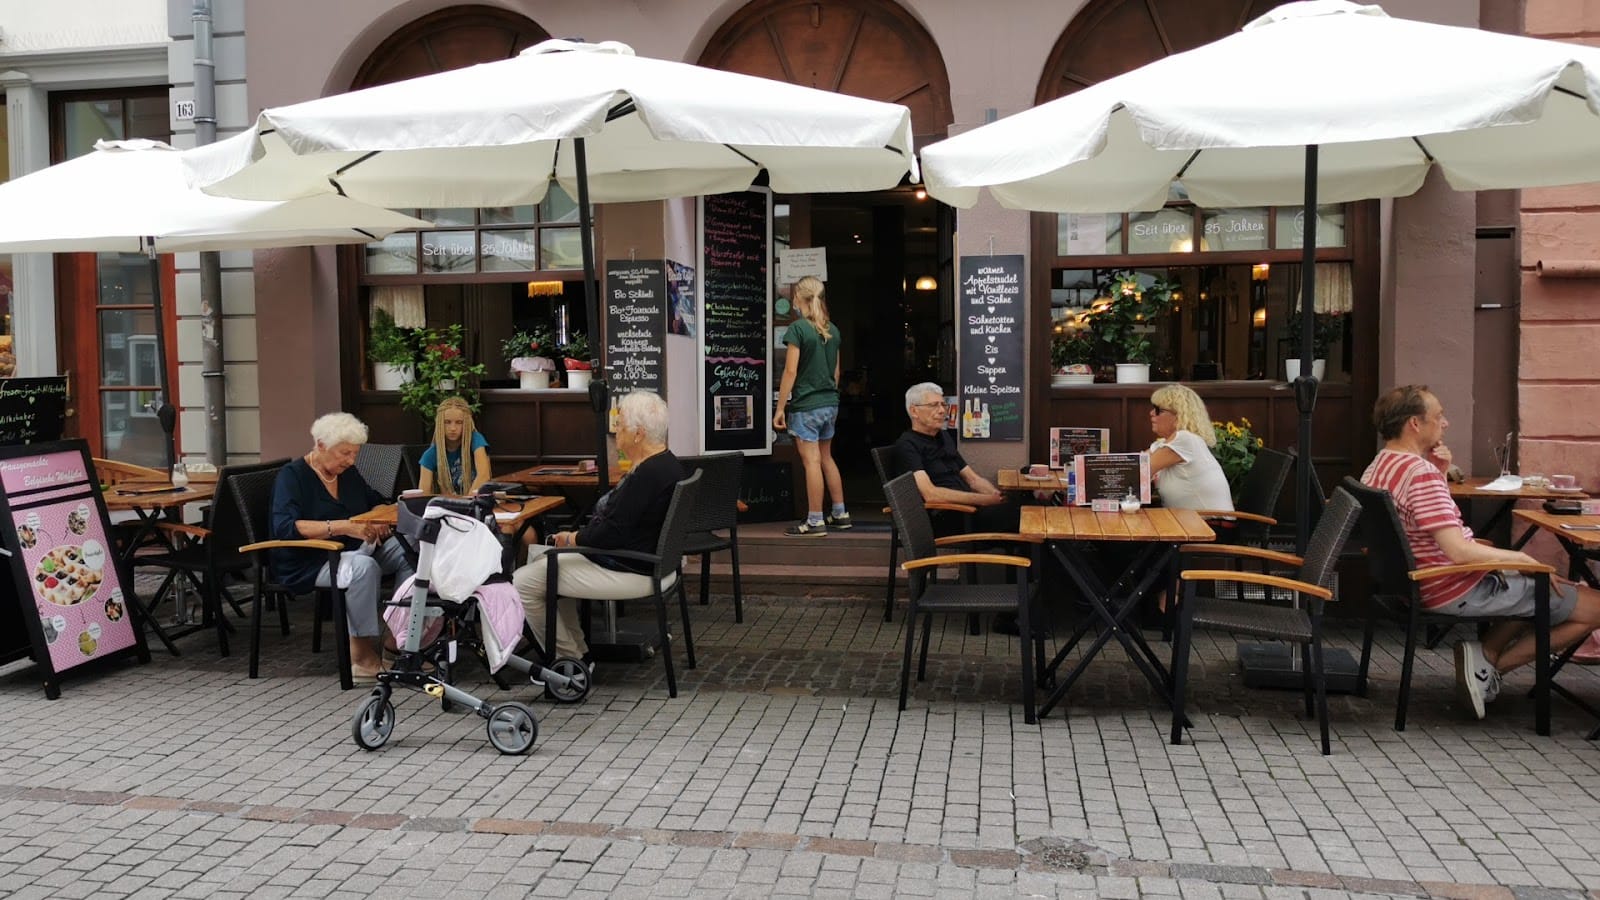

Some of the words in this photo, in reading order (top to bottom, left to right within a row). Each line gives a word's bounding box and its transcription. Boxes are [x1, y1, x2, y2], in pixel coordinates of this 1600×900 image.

[177, 103, 193, 117] 163
[1134, 223, 1158, 236] Seit
[1162, 222, 1186, 234] über
[1204, 222, 1220, 235] 35
[1224, 217, 1265, 233] Jahren
[422, 242, 447, 256] Seit
[450, 242, 476, 256] über
[481, 243, 496, 256] 35
[977, 266, 1005, 275] warmer
[963, 273, 1018, 292] Apfelstrudel
[965, 286, 977, 295] mit
[982, 284, 1019, 295] Vanilleeis
[970, 294, 985, 305] und
[986, 294, 1013, 305] Sahne
[619, 313, 650, 324] Espresso
[968, 314, 1016, 325] Sahnetorten
[970, 325, 985, 335] und
[985, 323, 1012, 334] Kuchen
[984, 344, 999, 354] Eis
[977, 365, 1007, 376] Suppen
[963, 384, 988, 394] Kleine
[989, 384, 1021, 396] Speisen
